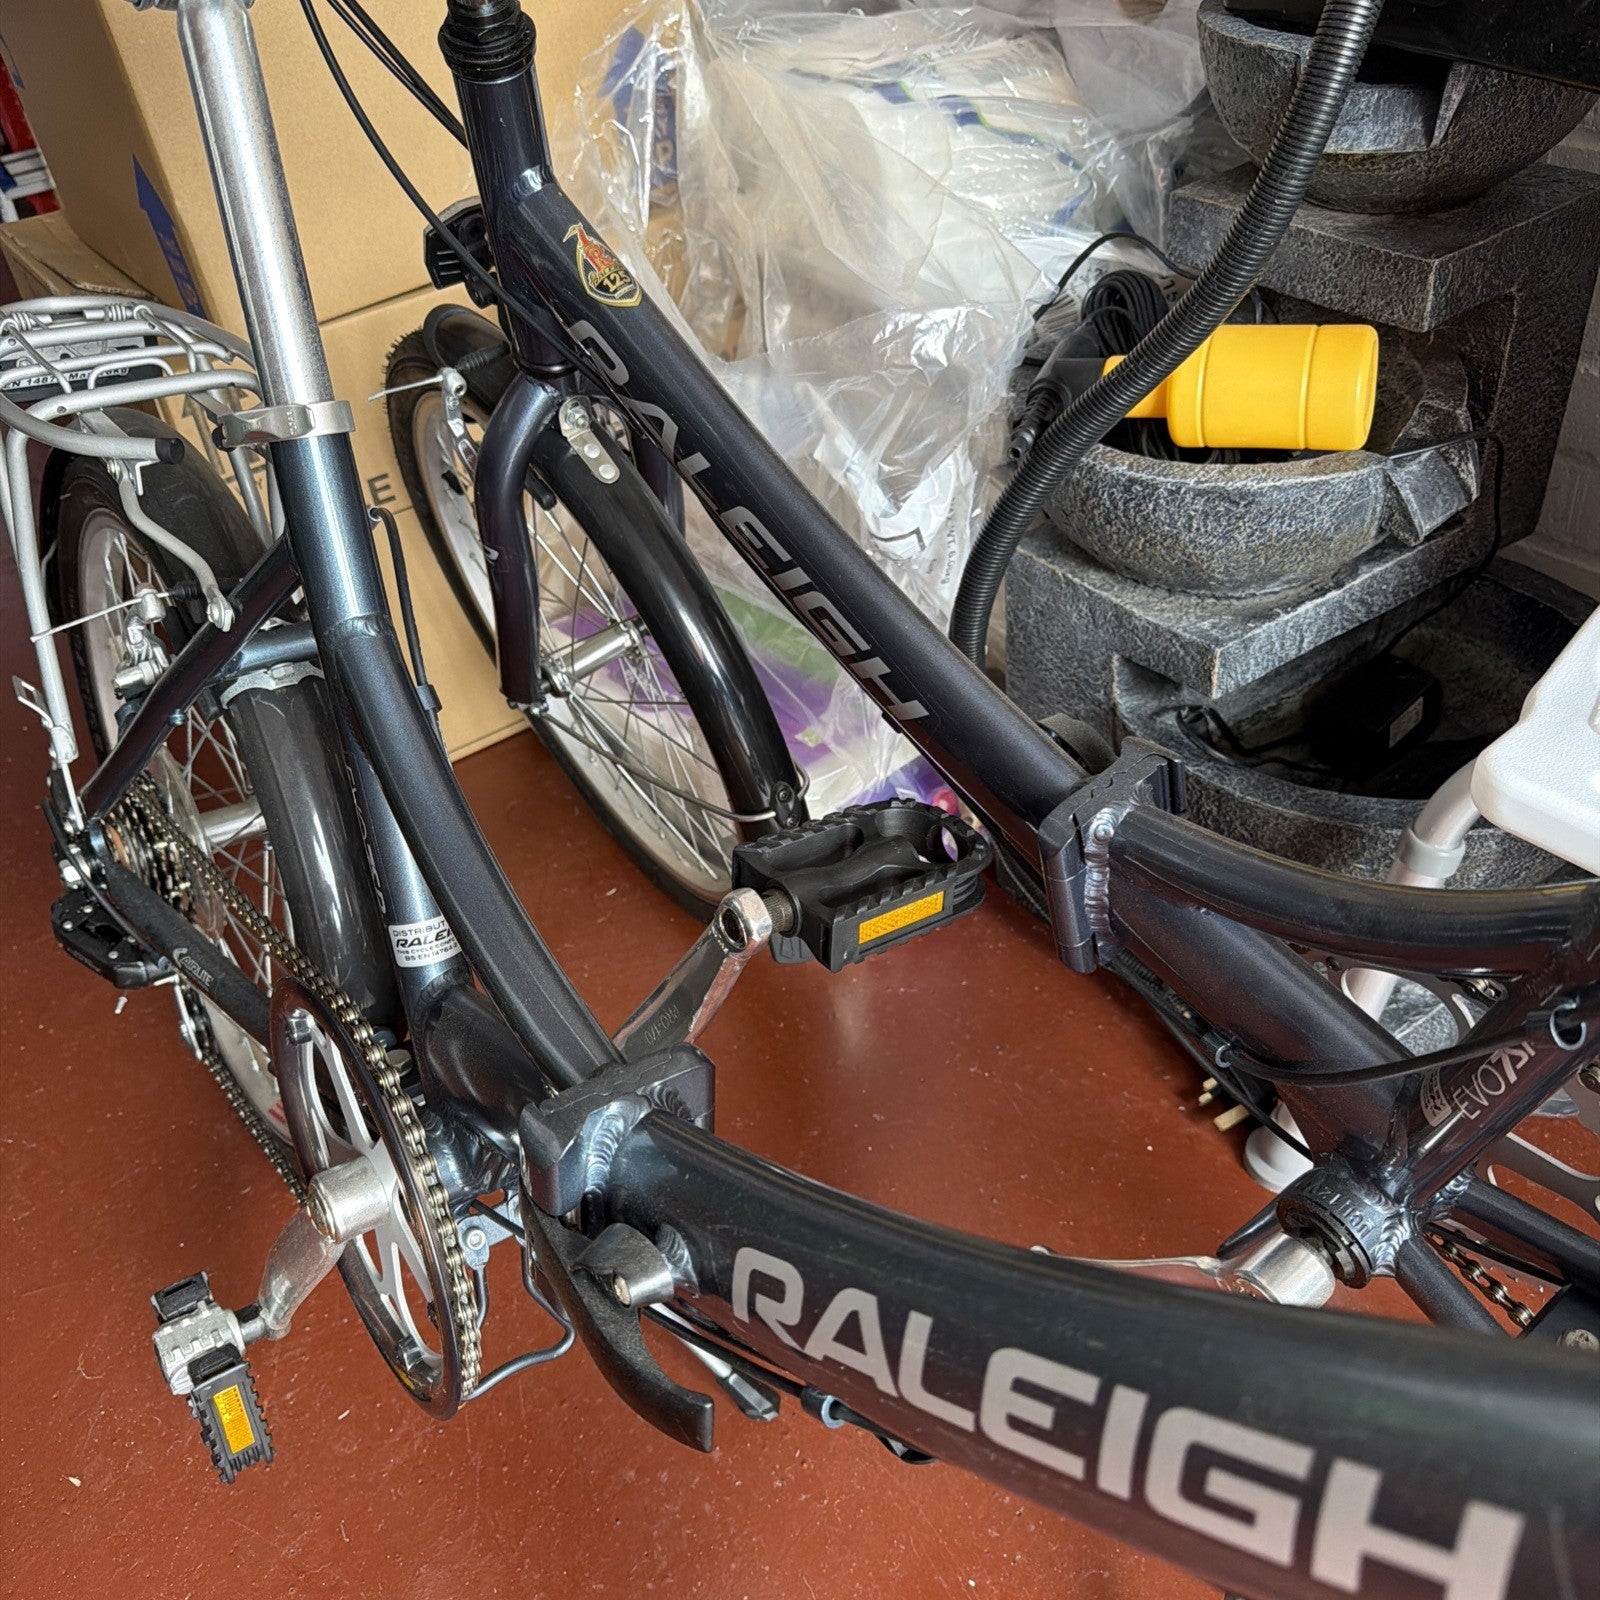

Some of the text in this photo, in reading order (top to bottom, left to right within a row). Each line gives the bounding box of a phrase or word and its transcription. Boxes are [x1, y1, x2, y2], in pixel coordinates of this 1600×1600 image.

[603, 270, 631, 292] 125
[27, 376, 58, 386] 1487
[571, 319, 931, 721] RALEIGH
[396, 928, 453, 948] RALEI
[731, 1246, 1526, 1600] RALEIGH
